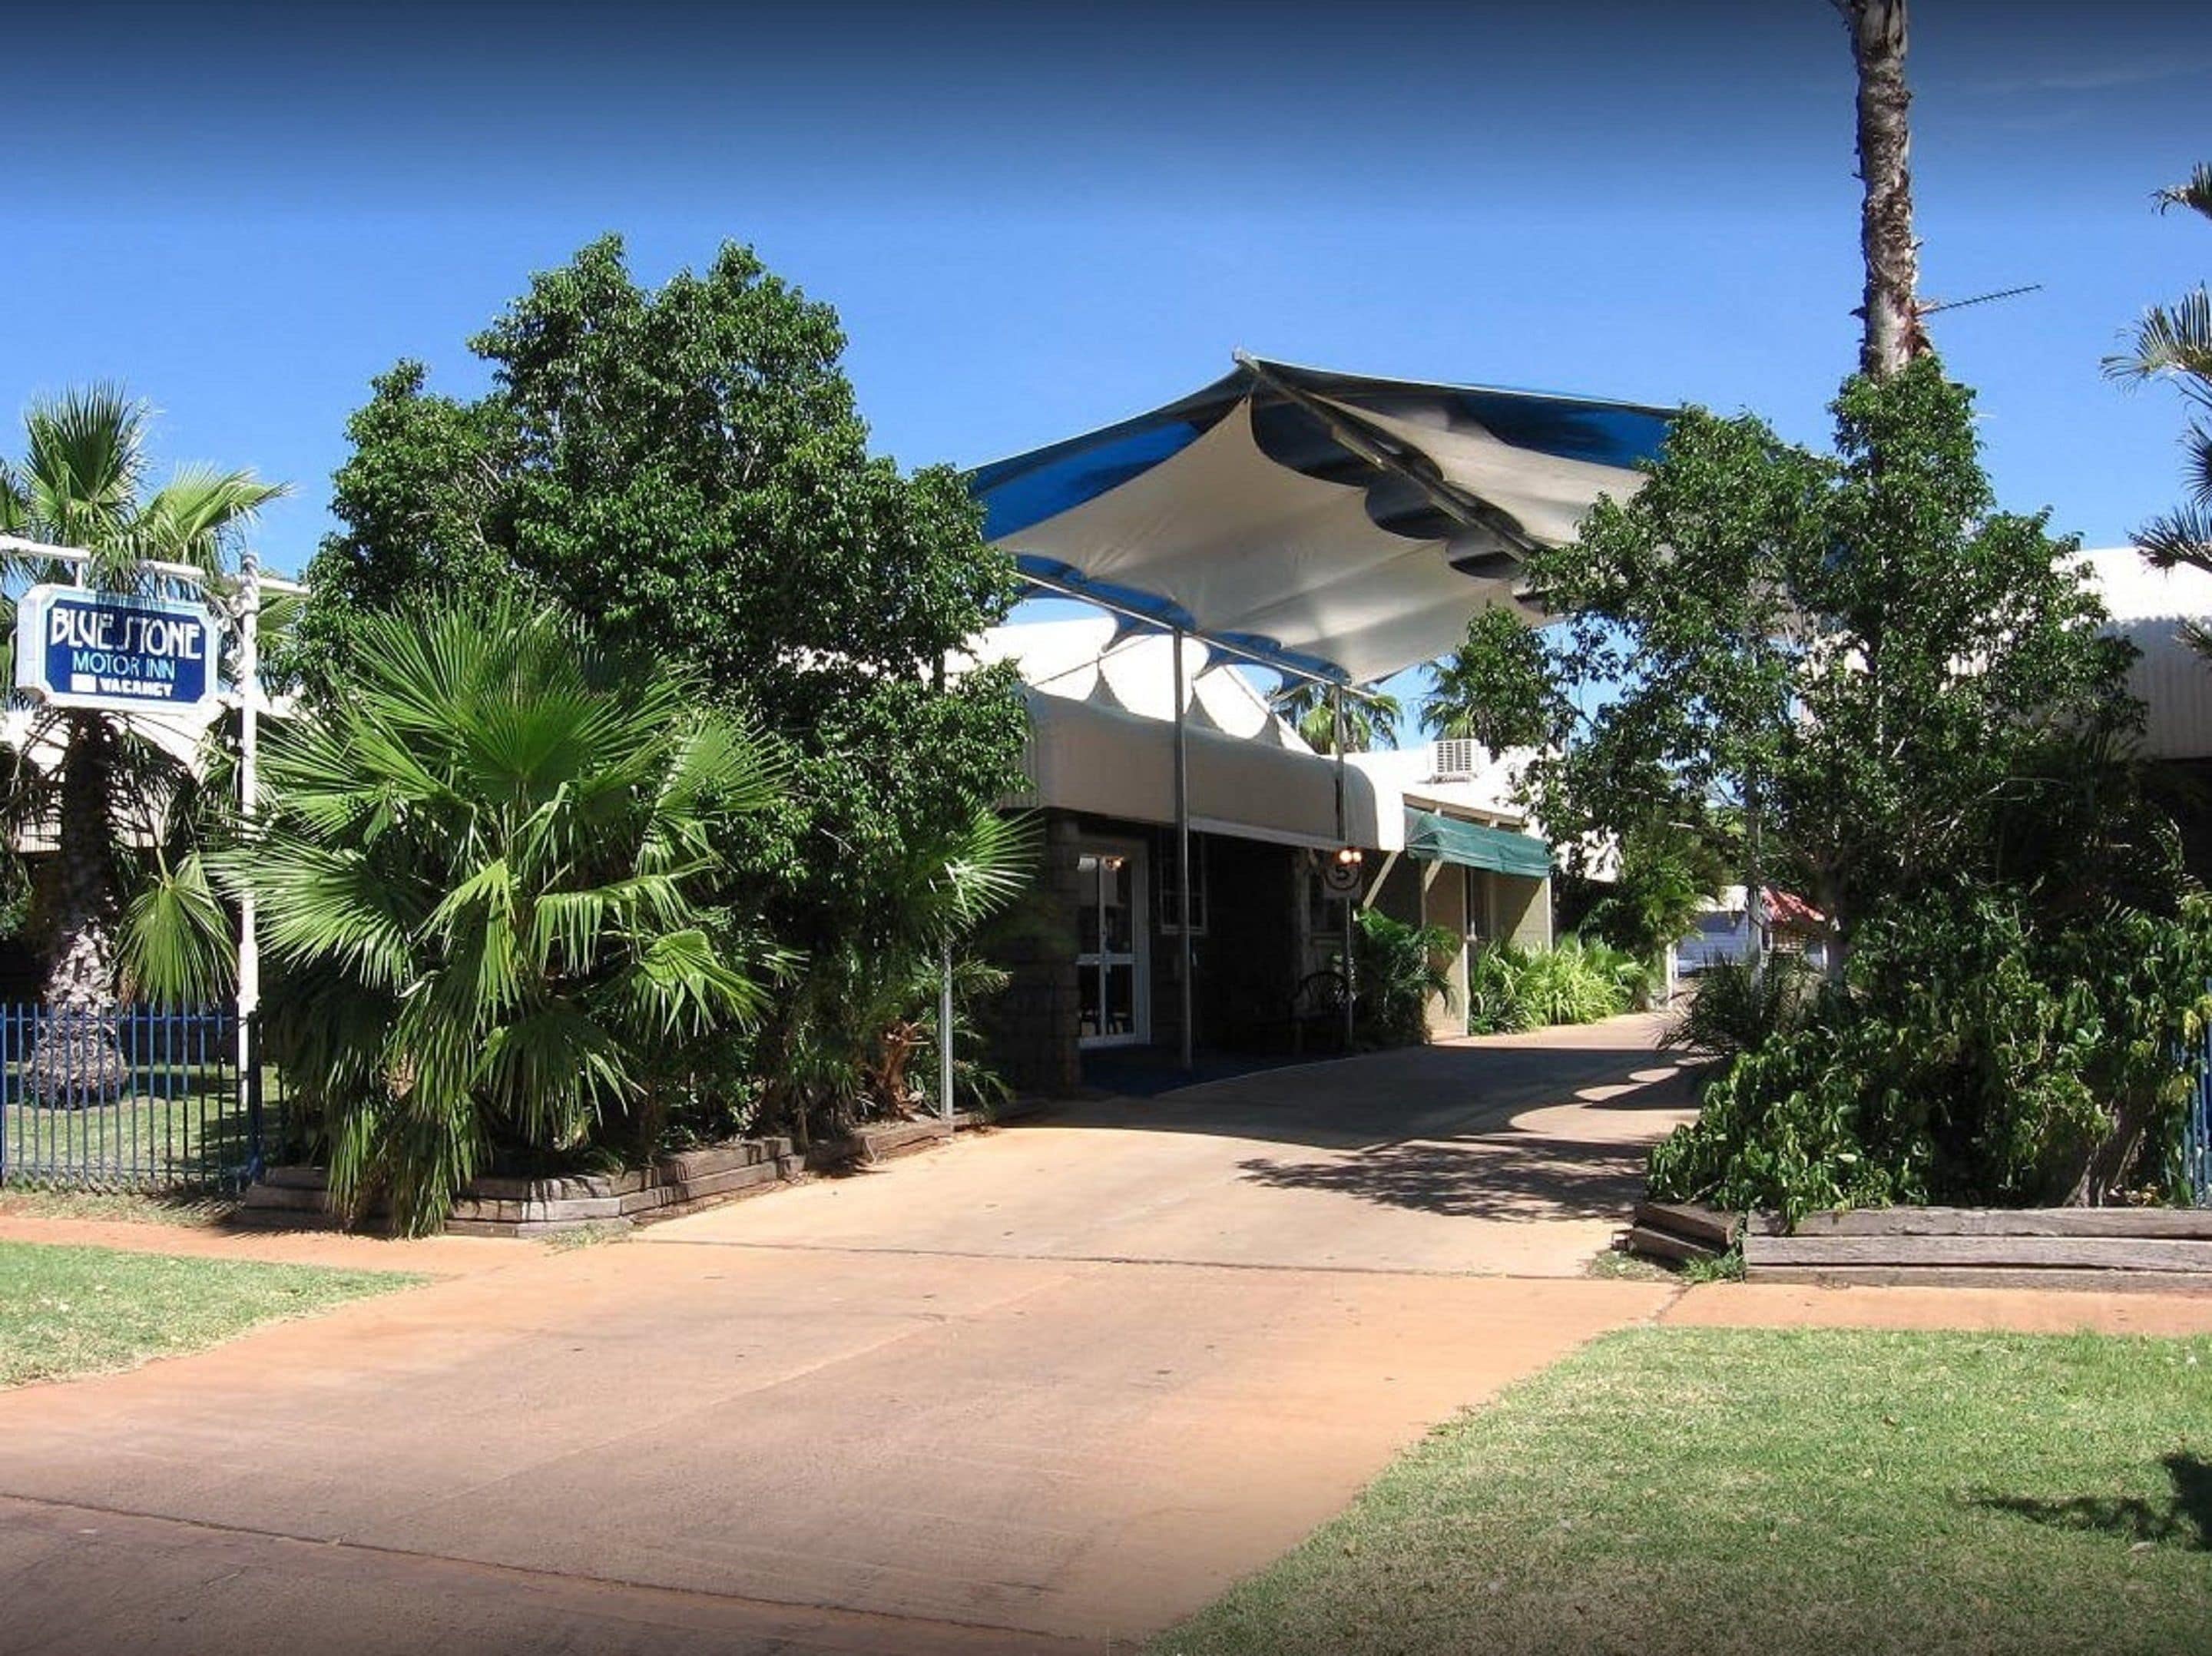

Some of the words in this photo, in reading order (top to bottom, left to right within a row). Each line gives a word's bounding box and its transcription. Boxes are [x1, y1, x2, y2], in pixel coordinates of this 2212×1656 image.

[50, 607, 114, 651] BLUE
[117, 616, 201, 659] STONE
[73, 651, 140, 677] MOTOR
[147, 658, 175, 680] INN
[99, 677, 173, 697] VACANCY
